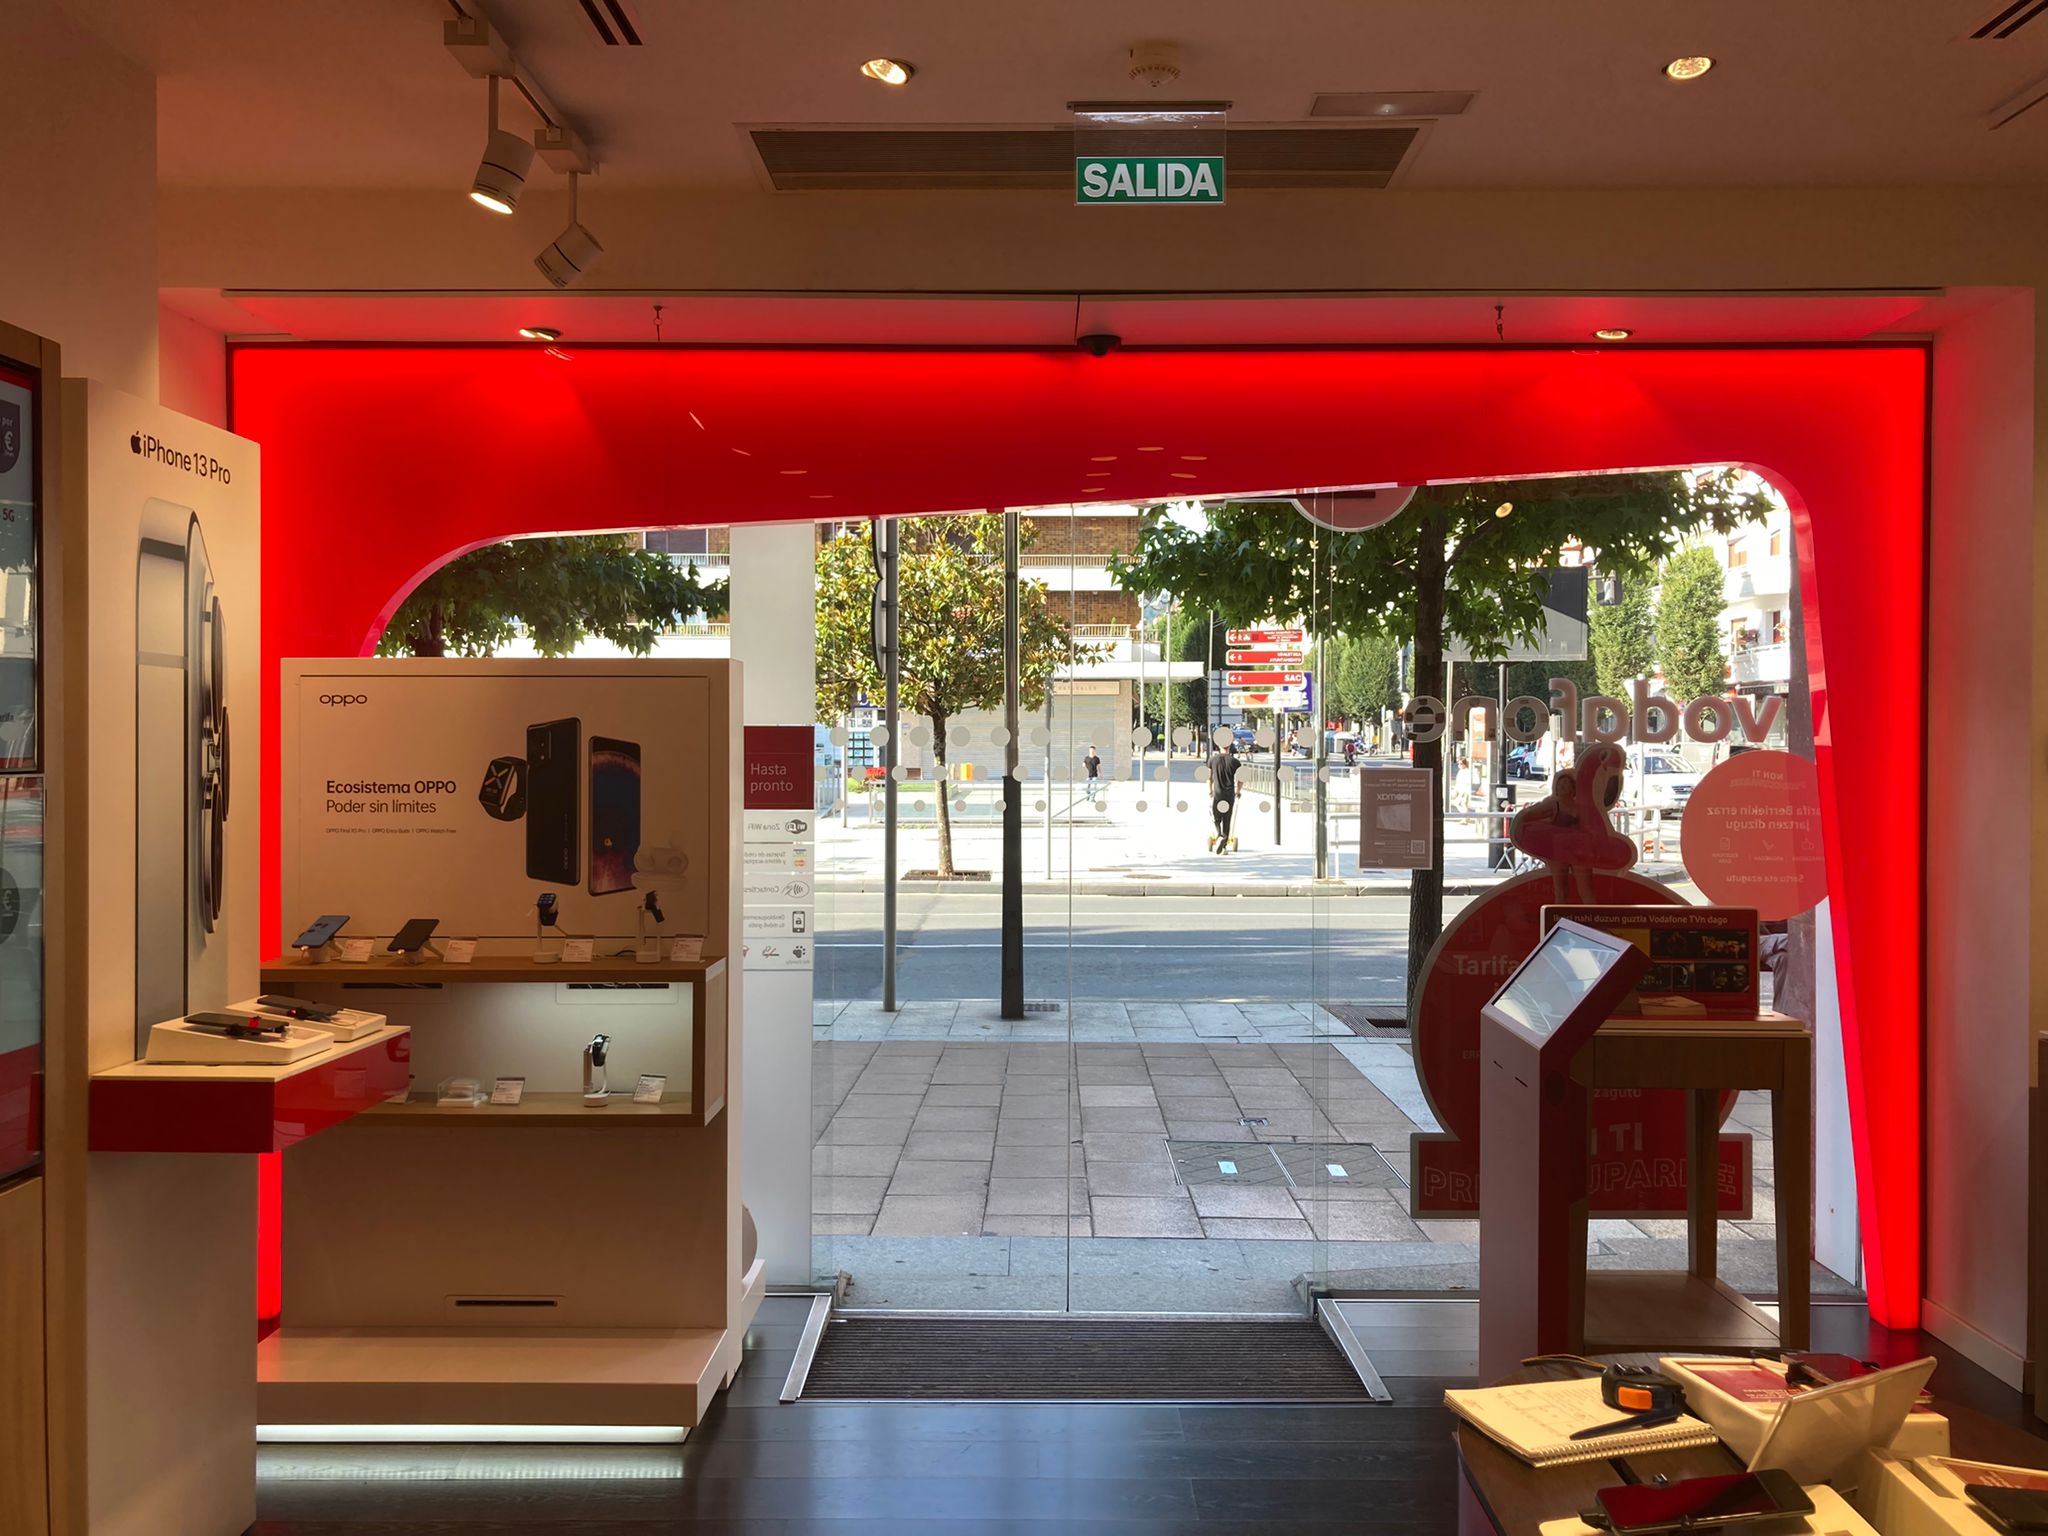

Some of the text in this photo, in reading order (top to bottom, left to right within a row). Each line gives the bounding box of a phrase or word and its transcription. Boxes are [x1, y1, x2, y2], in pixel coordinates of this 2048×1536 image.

[1082, 162, 1218, 198] SALIDA
[143, 434, 231, 485] iPhone 13 Pro
[2, 507, 15, 523] 5G
[1284, 673, 1302, 682] SAC
[750, 762, 787, 776] Hasta
[326, 780, 457, 794] Ecosistema OPPO
[750, 780, 794, 795] pronto
[326, 799, 437, 813] Poder sin límites
[1574, 913, 1593, 923] nahi
[1594, 914, 1620, 923] duzun
[1621, 914, 1648, 926] guztia
[1649, 914, 1688, 924] Vodafone
[1689, 915, 1706, 924] TVn
[1707, 915, 1728, 926] dago
[1453, 954, 1520, 976] Tarifa
[1608, 1121, 1643, 1153] TI
